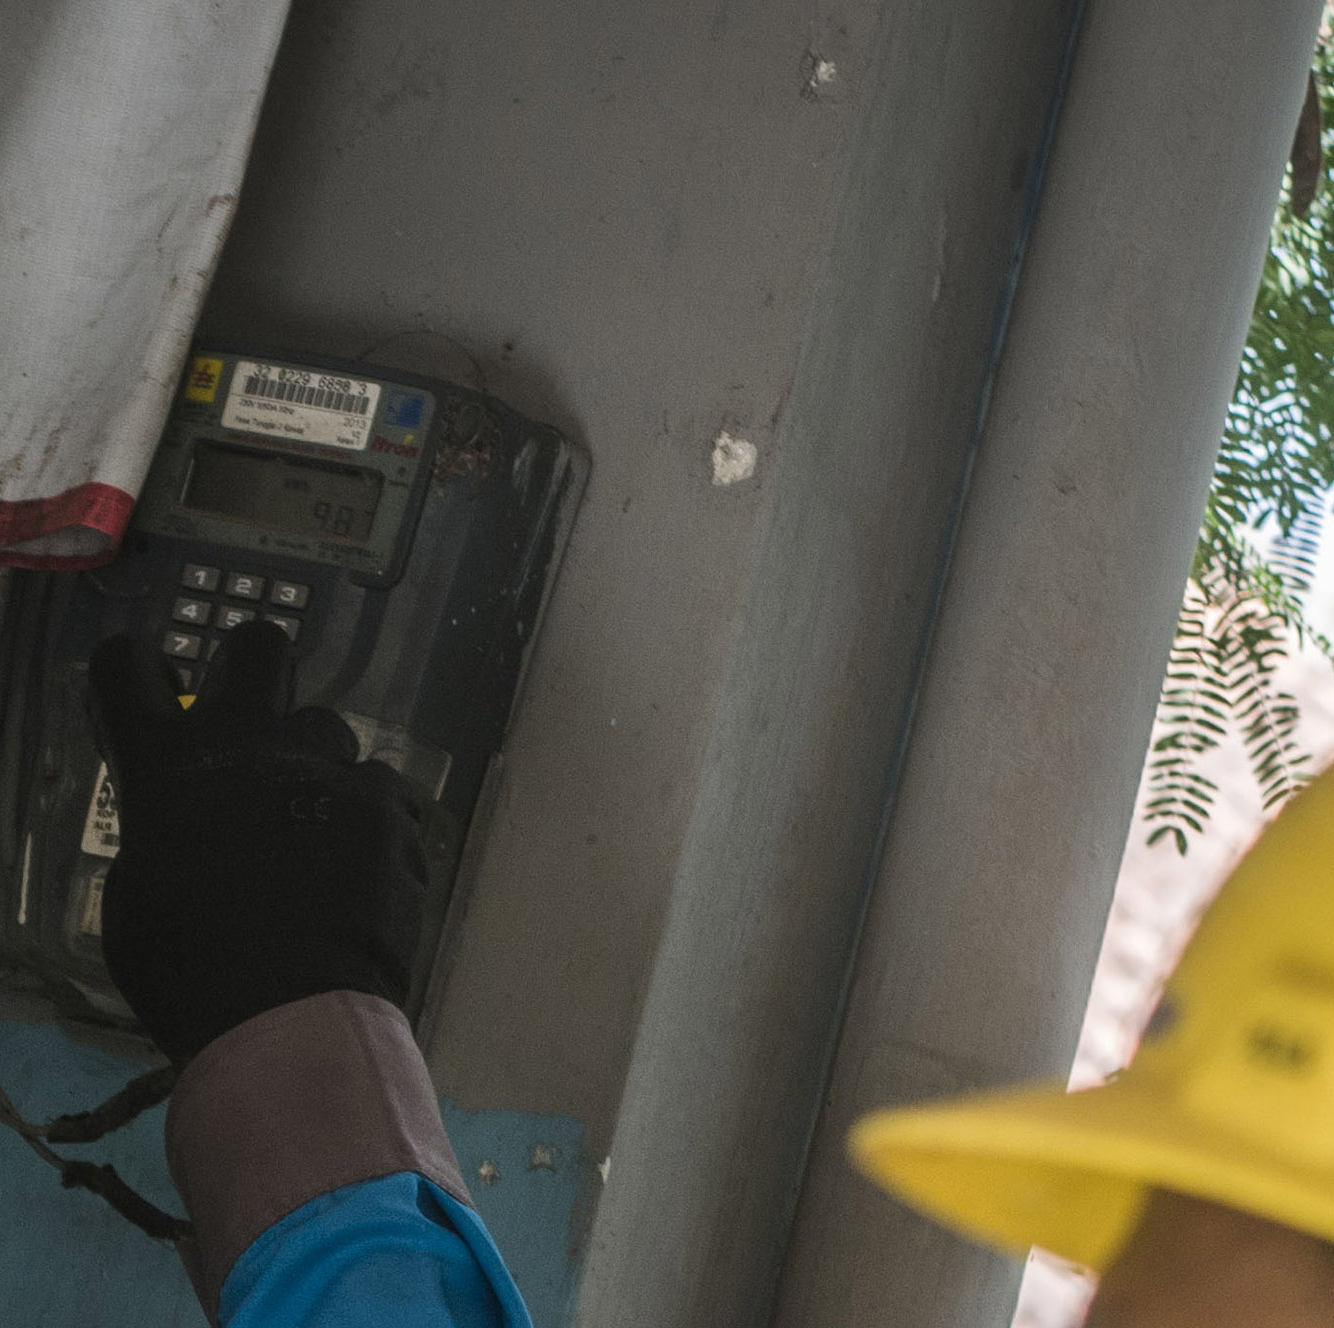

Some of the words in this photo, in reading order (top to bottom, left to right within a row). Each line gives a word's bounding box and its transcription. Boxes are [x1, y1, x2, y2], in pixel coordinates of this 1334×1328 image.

[278, 370, 311, 386] 0229
[358, 383, 367, 395] 3
[195, 570, 206, 586] 1
[235, 577, 252, 594] 2
[280, 586, 296, 601] 3
[182, 604, 197, 619] 4
[226, 611, 243, 627] 5
[173, 636, 188, 652] 7
